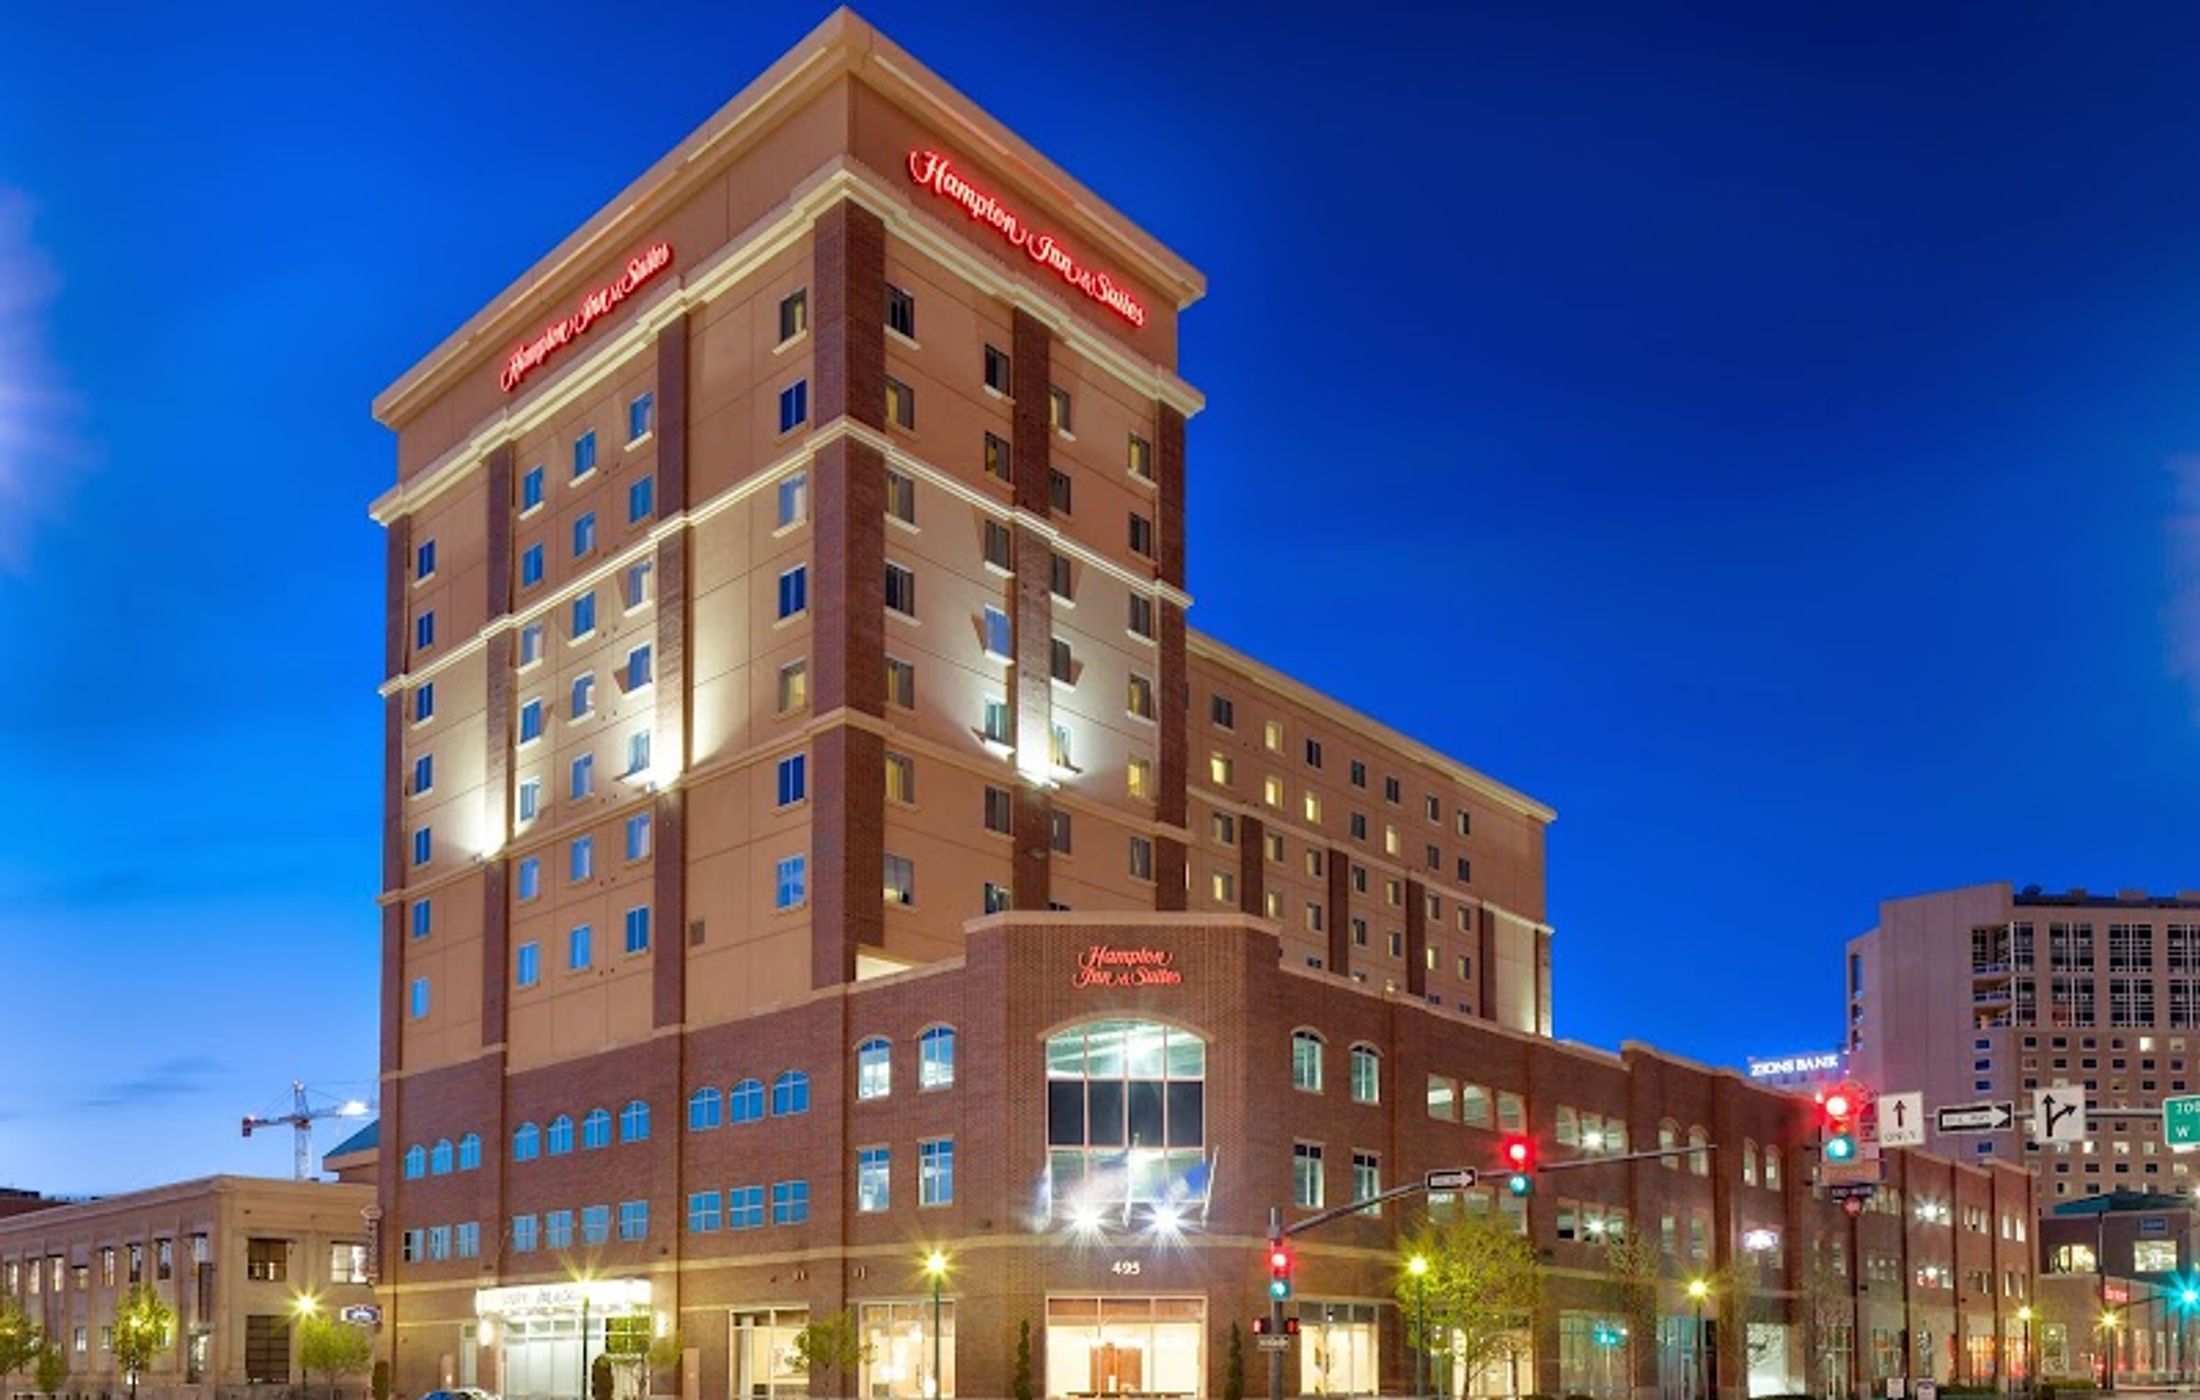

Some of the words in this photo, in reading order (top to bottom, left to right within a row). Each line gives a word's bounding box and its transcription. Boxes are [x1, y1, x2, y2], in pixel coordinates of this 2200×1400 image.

[909, 150, 1027, 245] Hampton
[1026, 234, 1081, 283] Inn
[1092, 272, 1143, 326] Suites
[500, 318, 575, 392] Hampton
[574, 289, 612, 334] Inn
[621, 243, 670, 293] Suites
[1078, 945, 1173, 968] Hampton
[1072, 967, 1118, 988] Inn
[1131, 966, 1181, 986] Suites
[1750, 1061, 1794, 1077] ZIONS
[1796, 1054, 1838, 1071] BANK
[2175, 1125, 2191, 1138] W
[1111, 1260, 1141, 1275] 495
